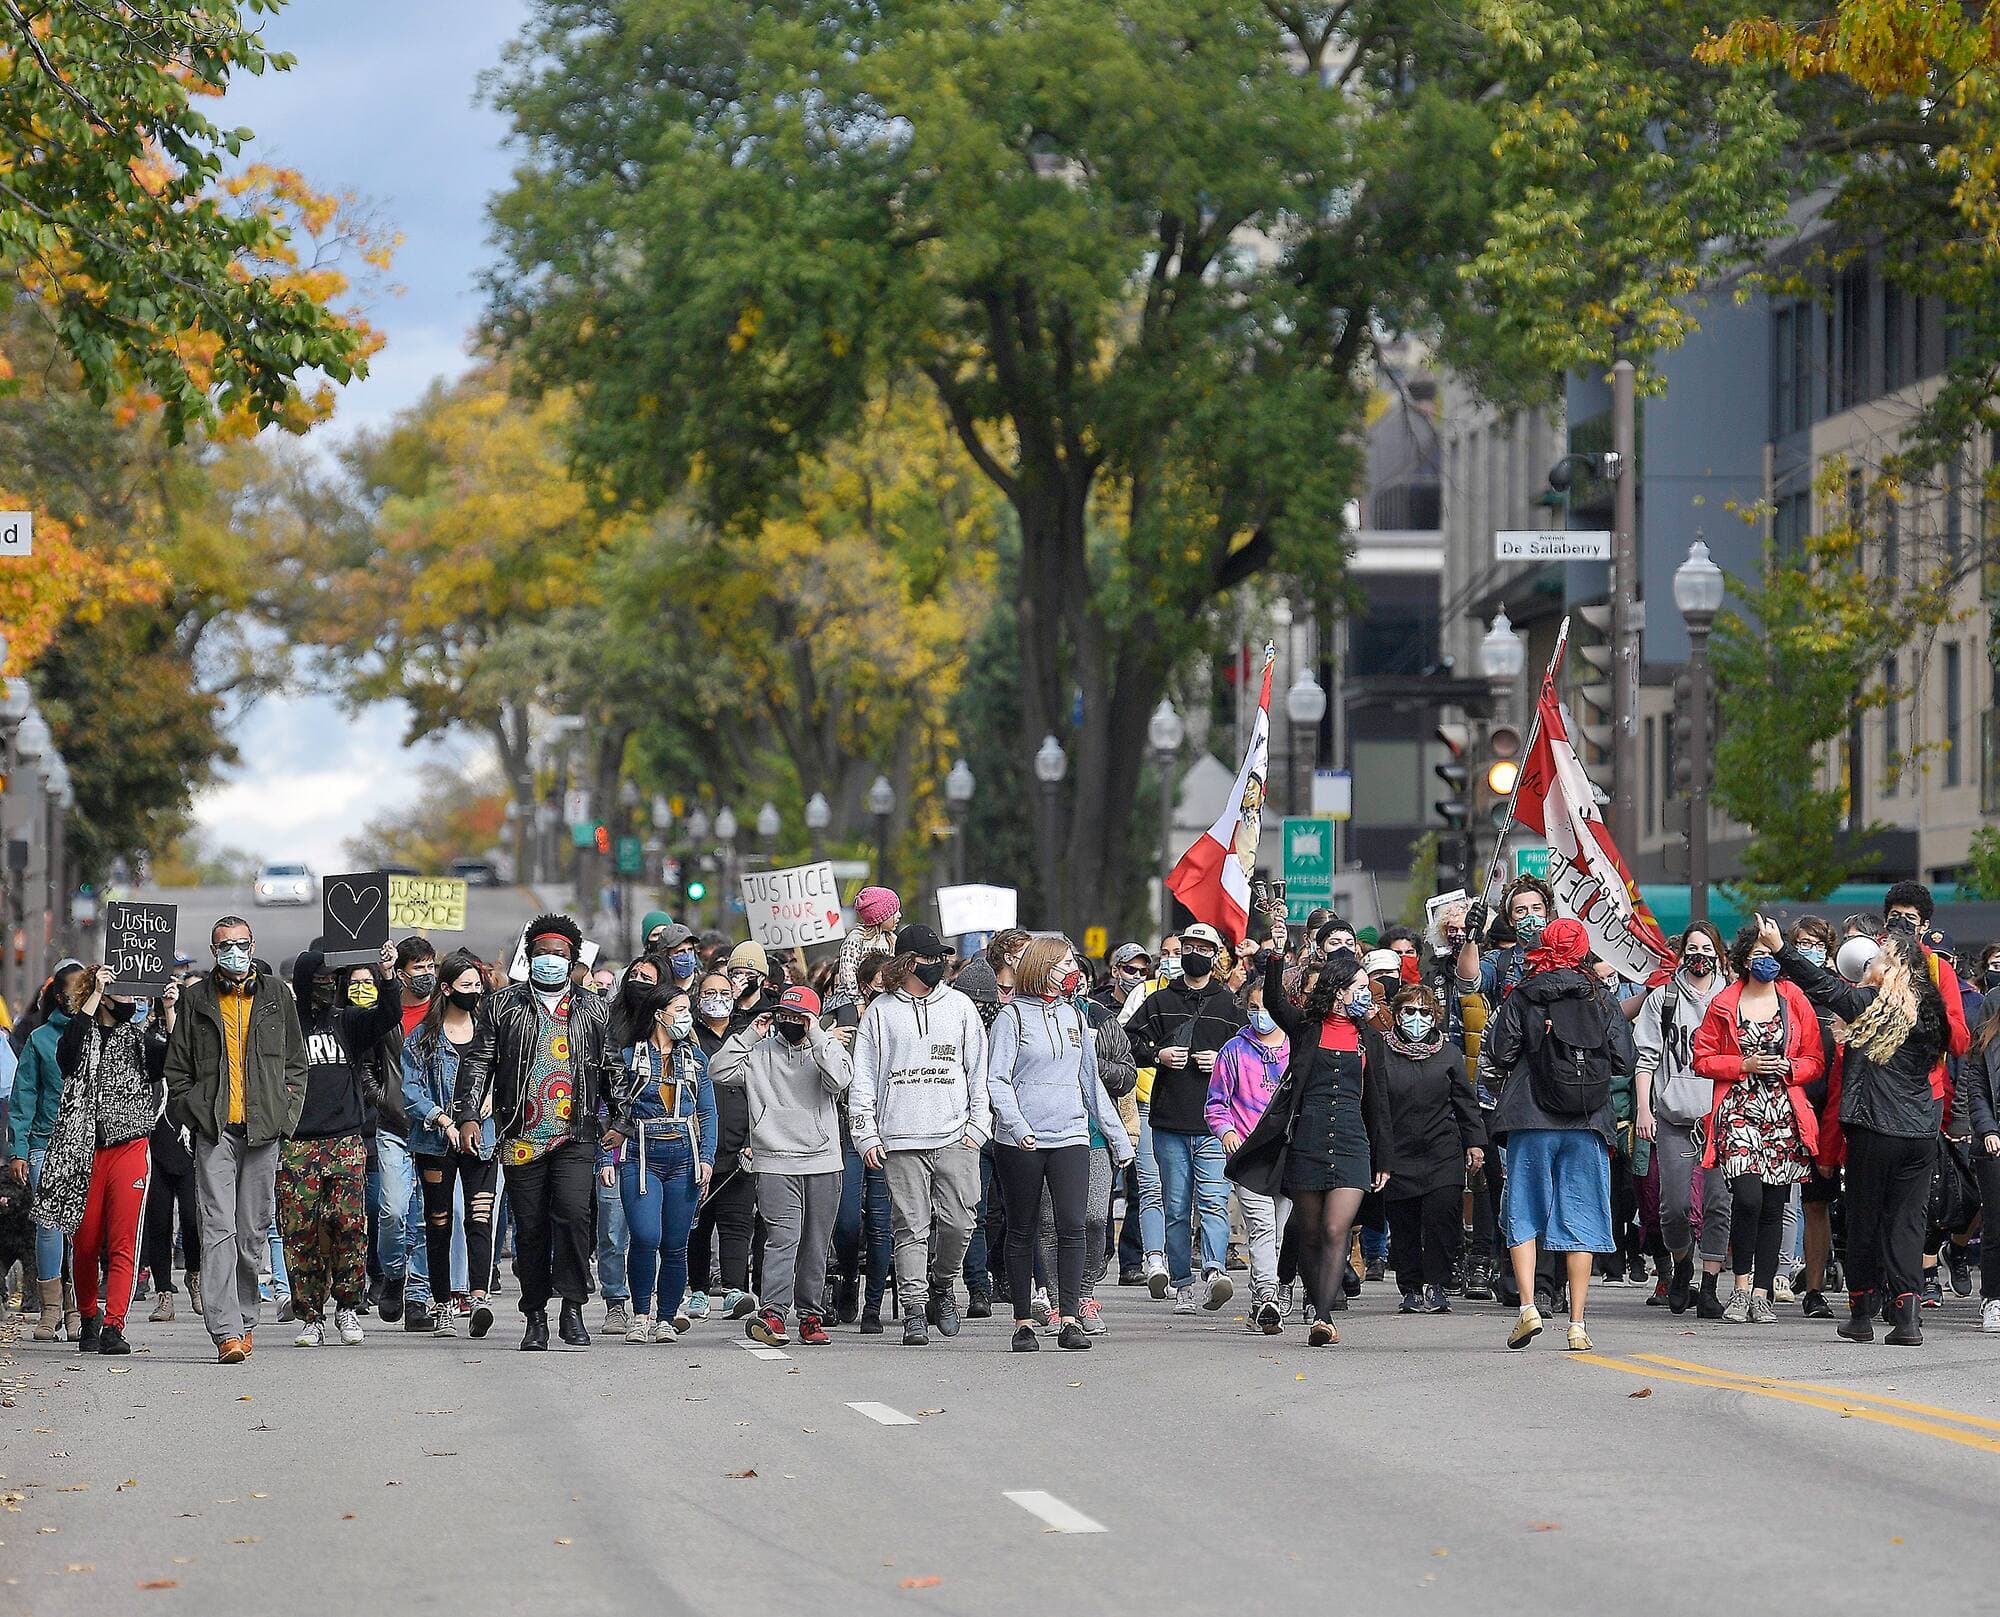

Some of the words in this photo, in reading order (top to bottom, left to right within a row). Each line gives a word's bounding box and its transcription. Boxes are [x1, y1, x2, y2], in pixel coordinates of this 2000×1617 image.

[0, 523, 18, 544] d
[1503, 543, 1521, 554] De
[1530, 542, 1601, 556] Salaberry
[1527, 853, 1549, 862] PRIO
[390, 881, 463, 900] JUSTICE
[743, 867, 832, 903] JUSTICE
[112, 908, 171, 934] Justice
[392, 903, 463, 926] JOYCE
[771, 902, 816, 920] POUR
[759, 920, 824, 945] JOYCE
[111, 948, 163, 979] Joyce
[920, 1067, 937, 1076] GOOD
[937, 1067, 950, 1075] GET
